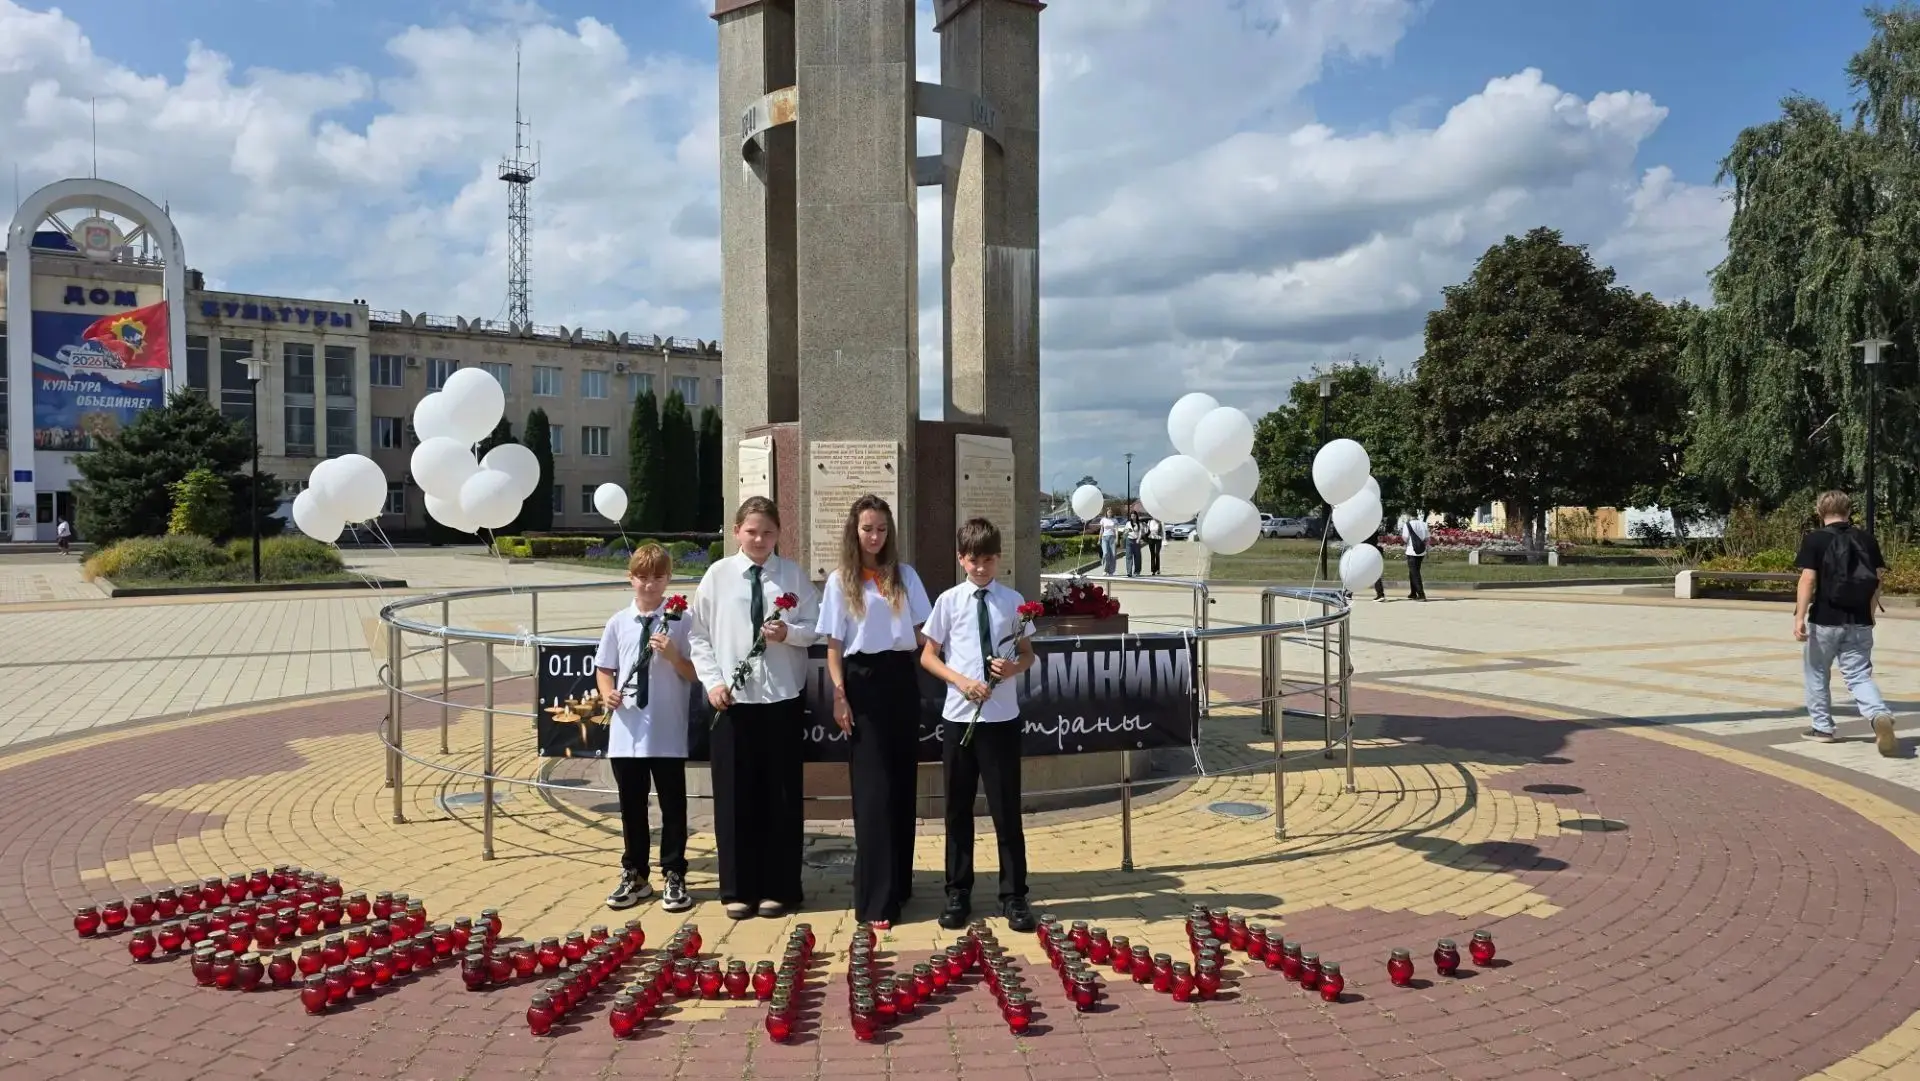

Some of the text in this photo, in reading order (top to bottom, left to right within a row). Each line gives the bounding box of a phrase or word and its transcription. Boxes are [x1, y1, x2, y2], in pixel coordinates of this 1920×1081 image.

[64, 285, 138, 306] ДОМ
[201, 301, 352, 328] КУЛЬТУРЫ
[72, 355, 103, 366] 2026
[42, 379, 102, 393] КУЛЬТУРА
[76, 395, 153, 409] ОБЪЕДИНЯЕТ
[1021, 714, 1153, 752] траны
